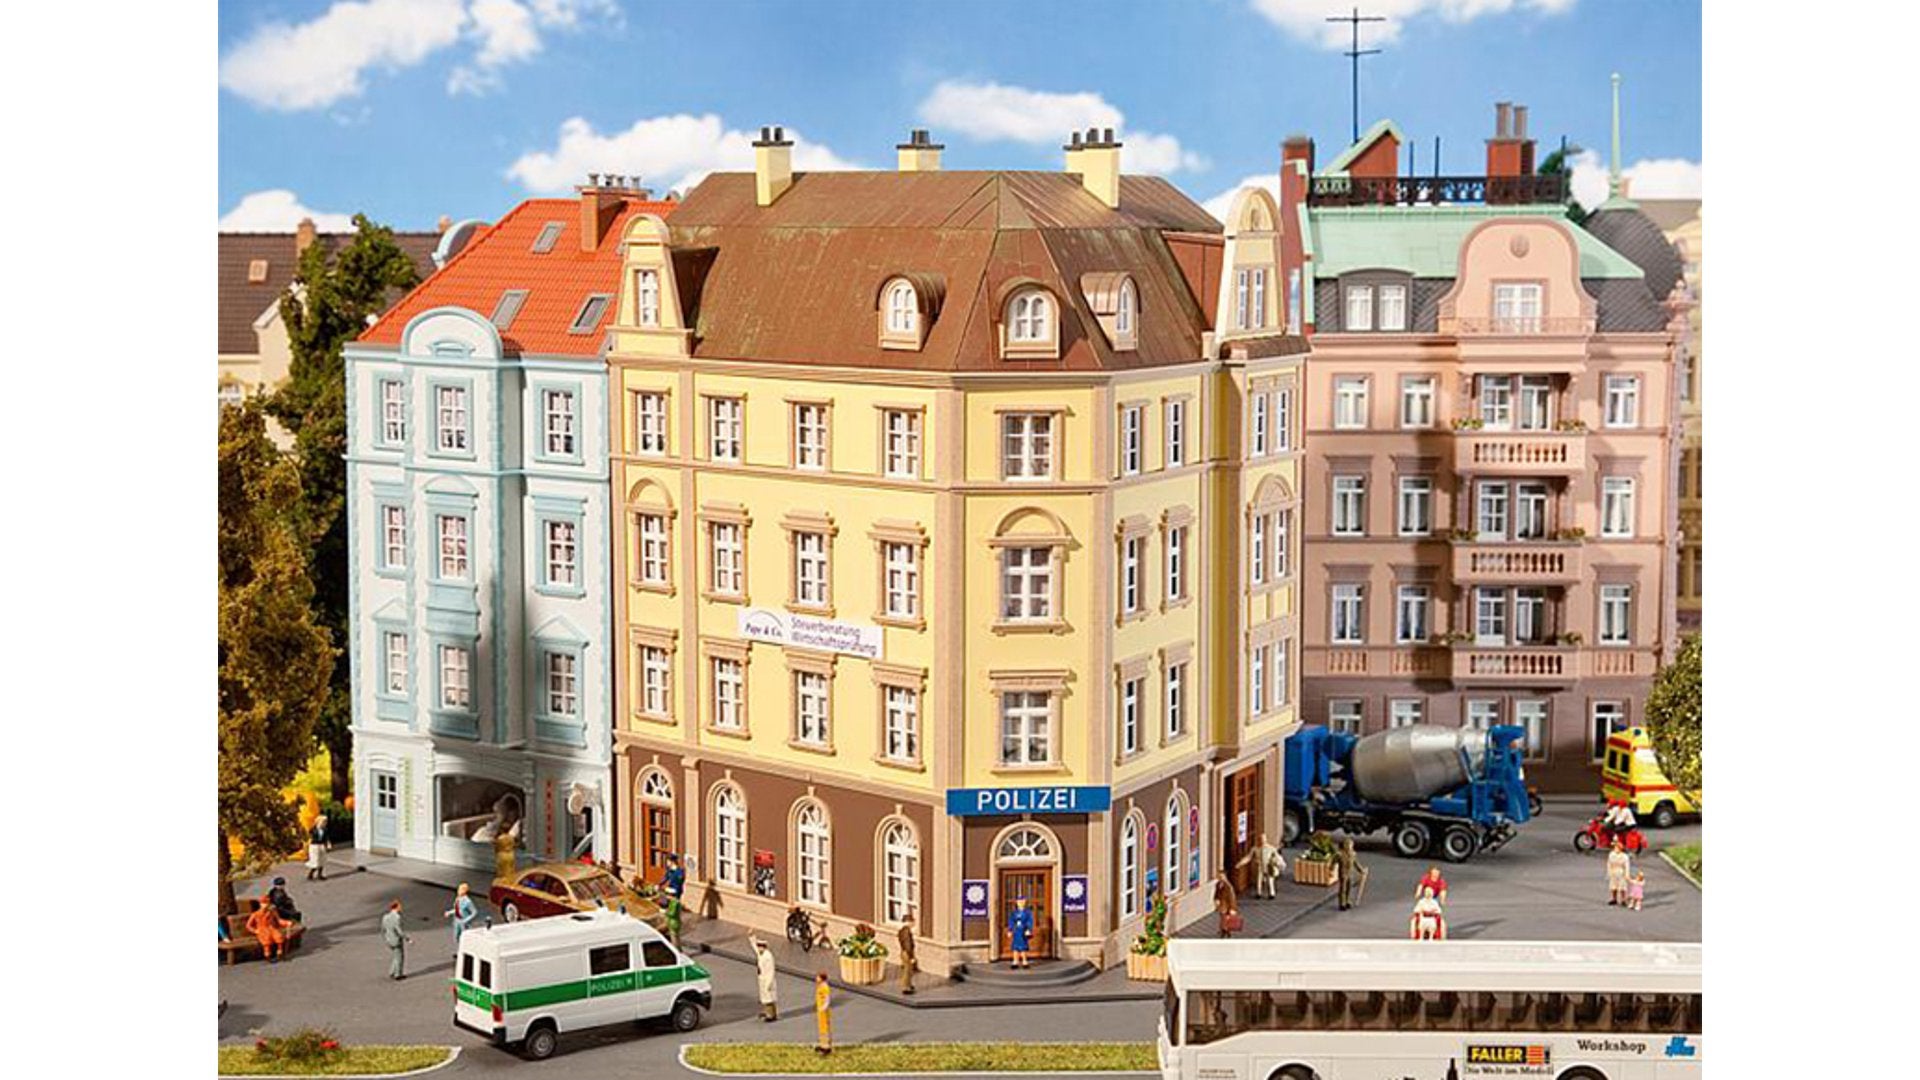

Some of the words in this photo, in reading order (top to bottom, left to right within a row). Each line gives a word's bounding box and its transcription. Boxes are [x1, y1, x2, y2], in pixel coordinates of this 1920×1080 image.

[790, 616, 861, 642] Steuerberatung
[791, 631, 877, 656] Wirtschaftsprüfung
[977, 788, 1076, 811] POLIZEI
[1471, 1047, 1522, 1061] FALLER
[1577, 1039, 1646, 1054] Workshop
